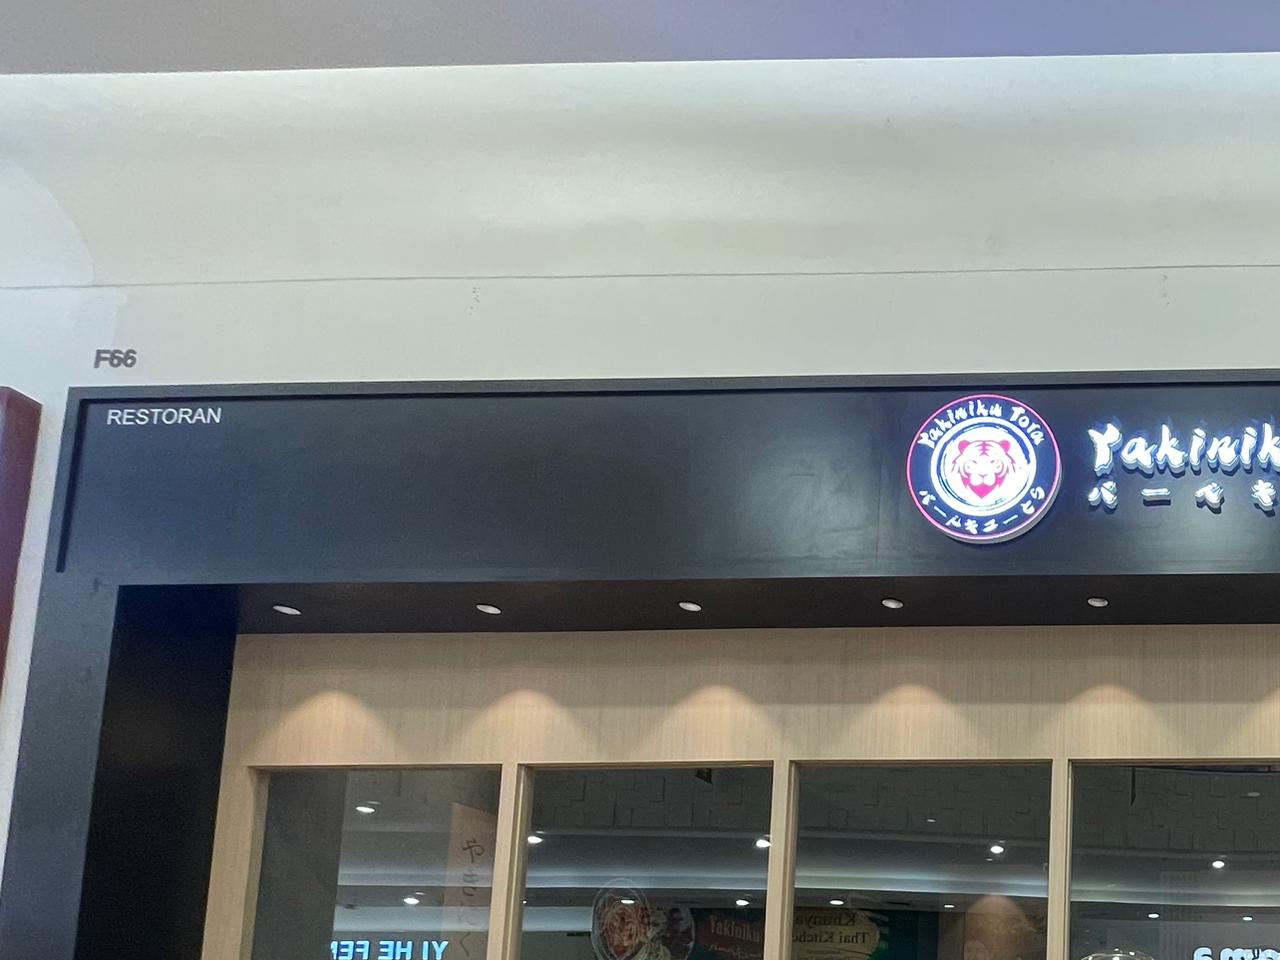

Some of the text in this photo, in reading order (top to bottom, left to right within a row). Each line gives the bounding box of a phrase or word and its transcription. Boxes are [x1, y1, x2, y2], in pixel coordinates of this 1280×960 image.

[93, 348, 138, 369] F66
[106, 407, 222, 425] RESTORAN
[917, 400, 1046, 450] Yakiniku Tora
